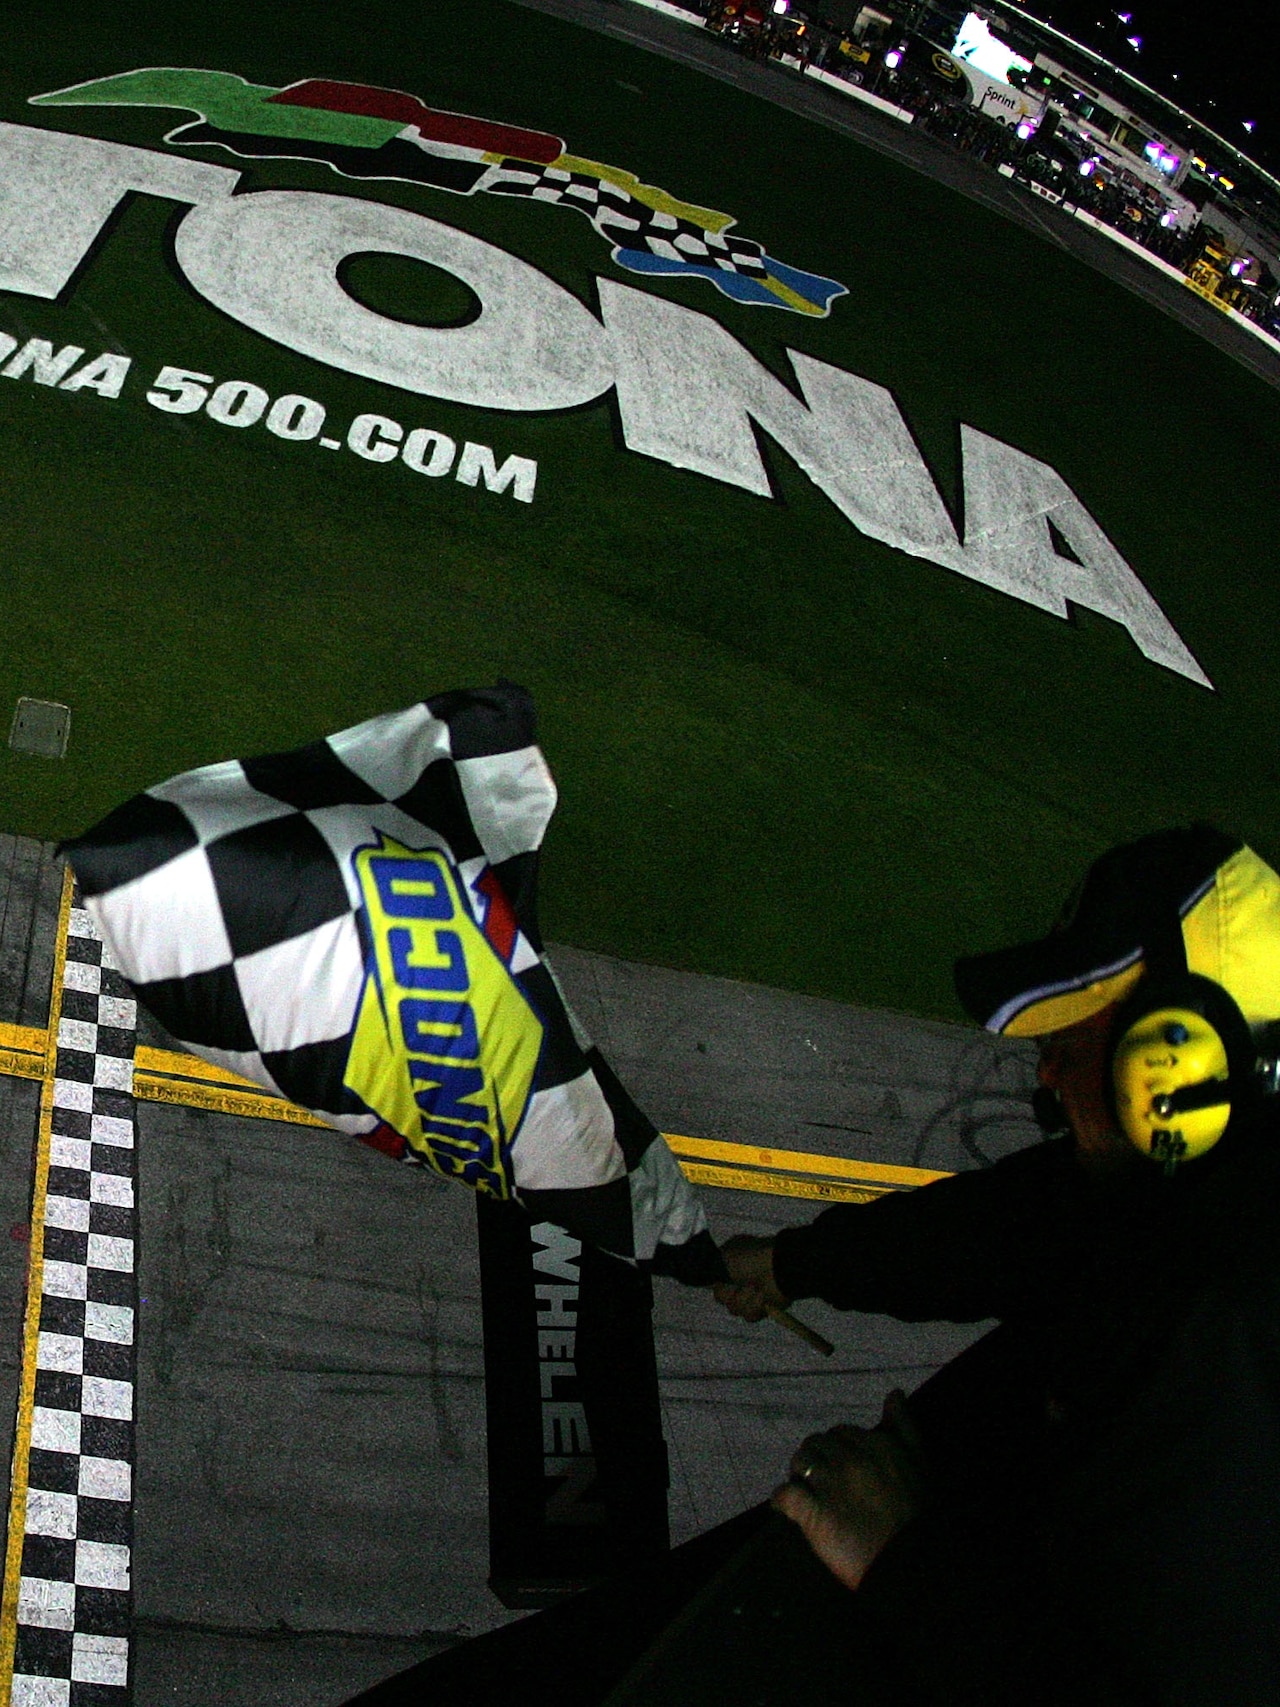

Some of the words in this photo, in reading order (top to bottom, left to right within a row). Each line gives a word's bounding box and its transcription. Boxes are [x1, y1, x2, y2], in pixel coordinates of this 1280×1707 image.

[986, 87, 1016, 110] Sprint
[145, 366, 539, 503] 500.COM
[368, 856, 503, 1200] SUNOCO
[530, 1220, 606, 1527] WHELEN
